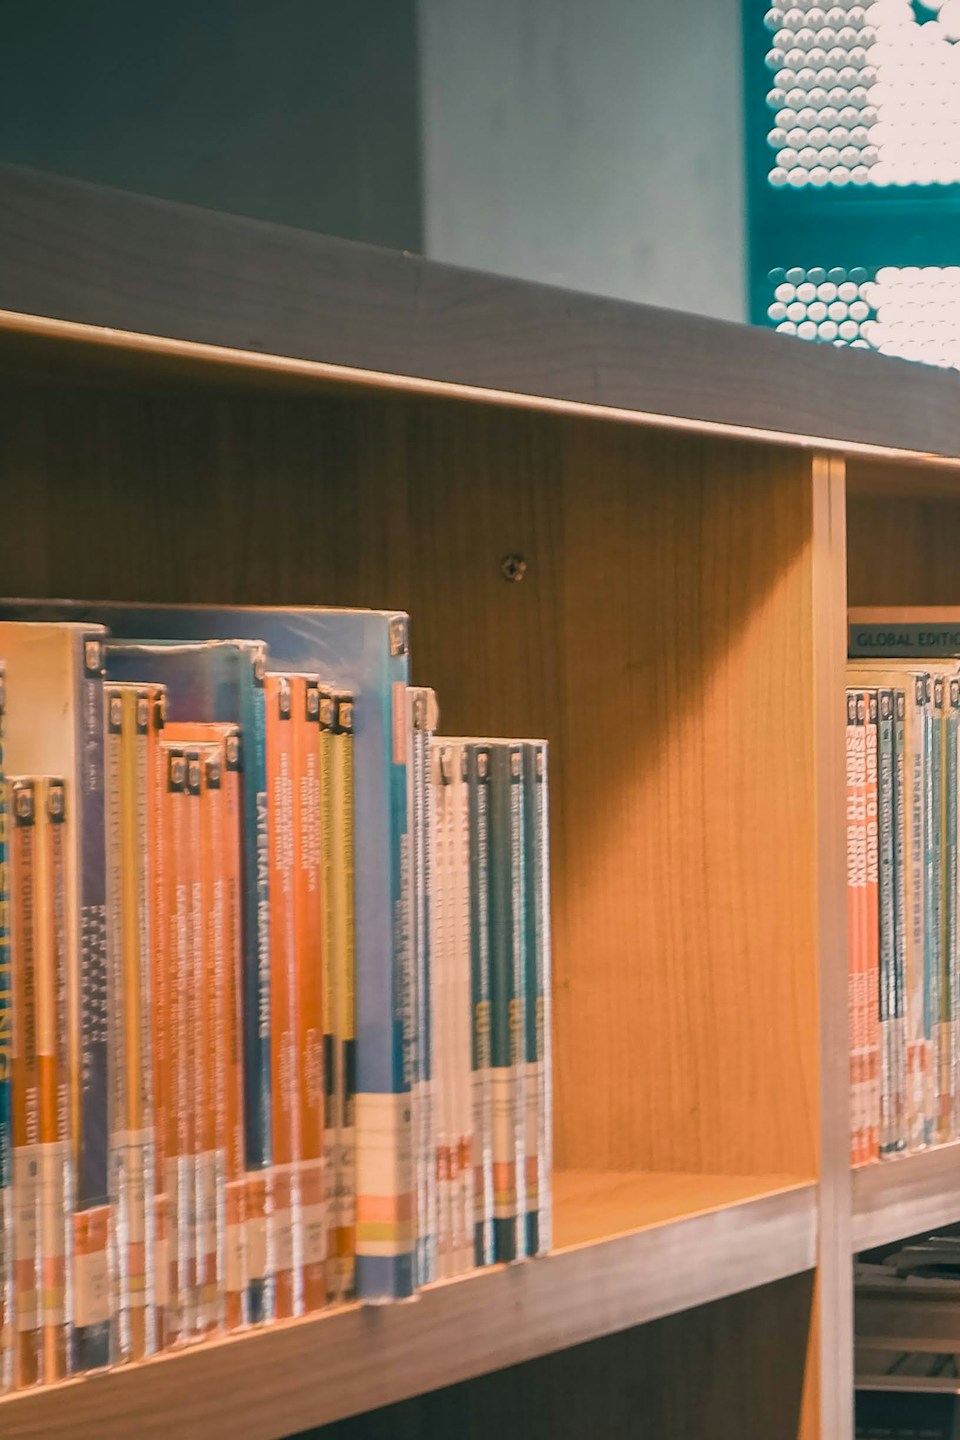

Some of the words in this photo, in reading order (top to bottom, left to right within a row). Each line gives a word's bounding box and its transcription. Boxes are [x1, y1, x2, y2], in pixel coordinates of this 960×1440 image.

[856, 632, 914, 647] GLOBAL
[847, 728, 857, 785] ESIGN
[857, 727, 867, 784] ESIGN
[867, 725, 878, 782] ESIGN
[847, 795, 857, 822] TO
[857, 794, 867, 821] TO
[867, 792, 878, 819] TO
[912, 754, 921, 862] MANAJEMEN
[256, 791, 269, 893] LATERAL
[857, 825, 867, 885] GROW
[867, 822, 878, 882] GROW
[257, 899, 271, 1040] MARKETING
